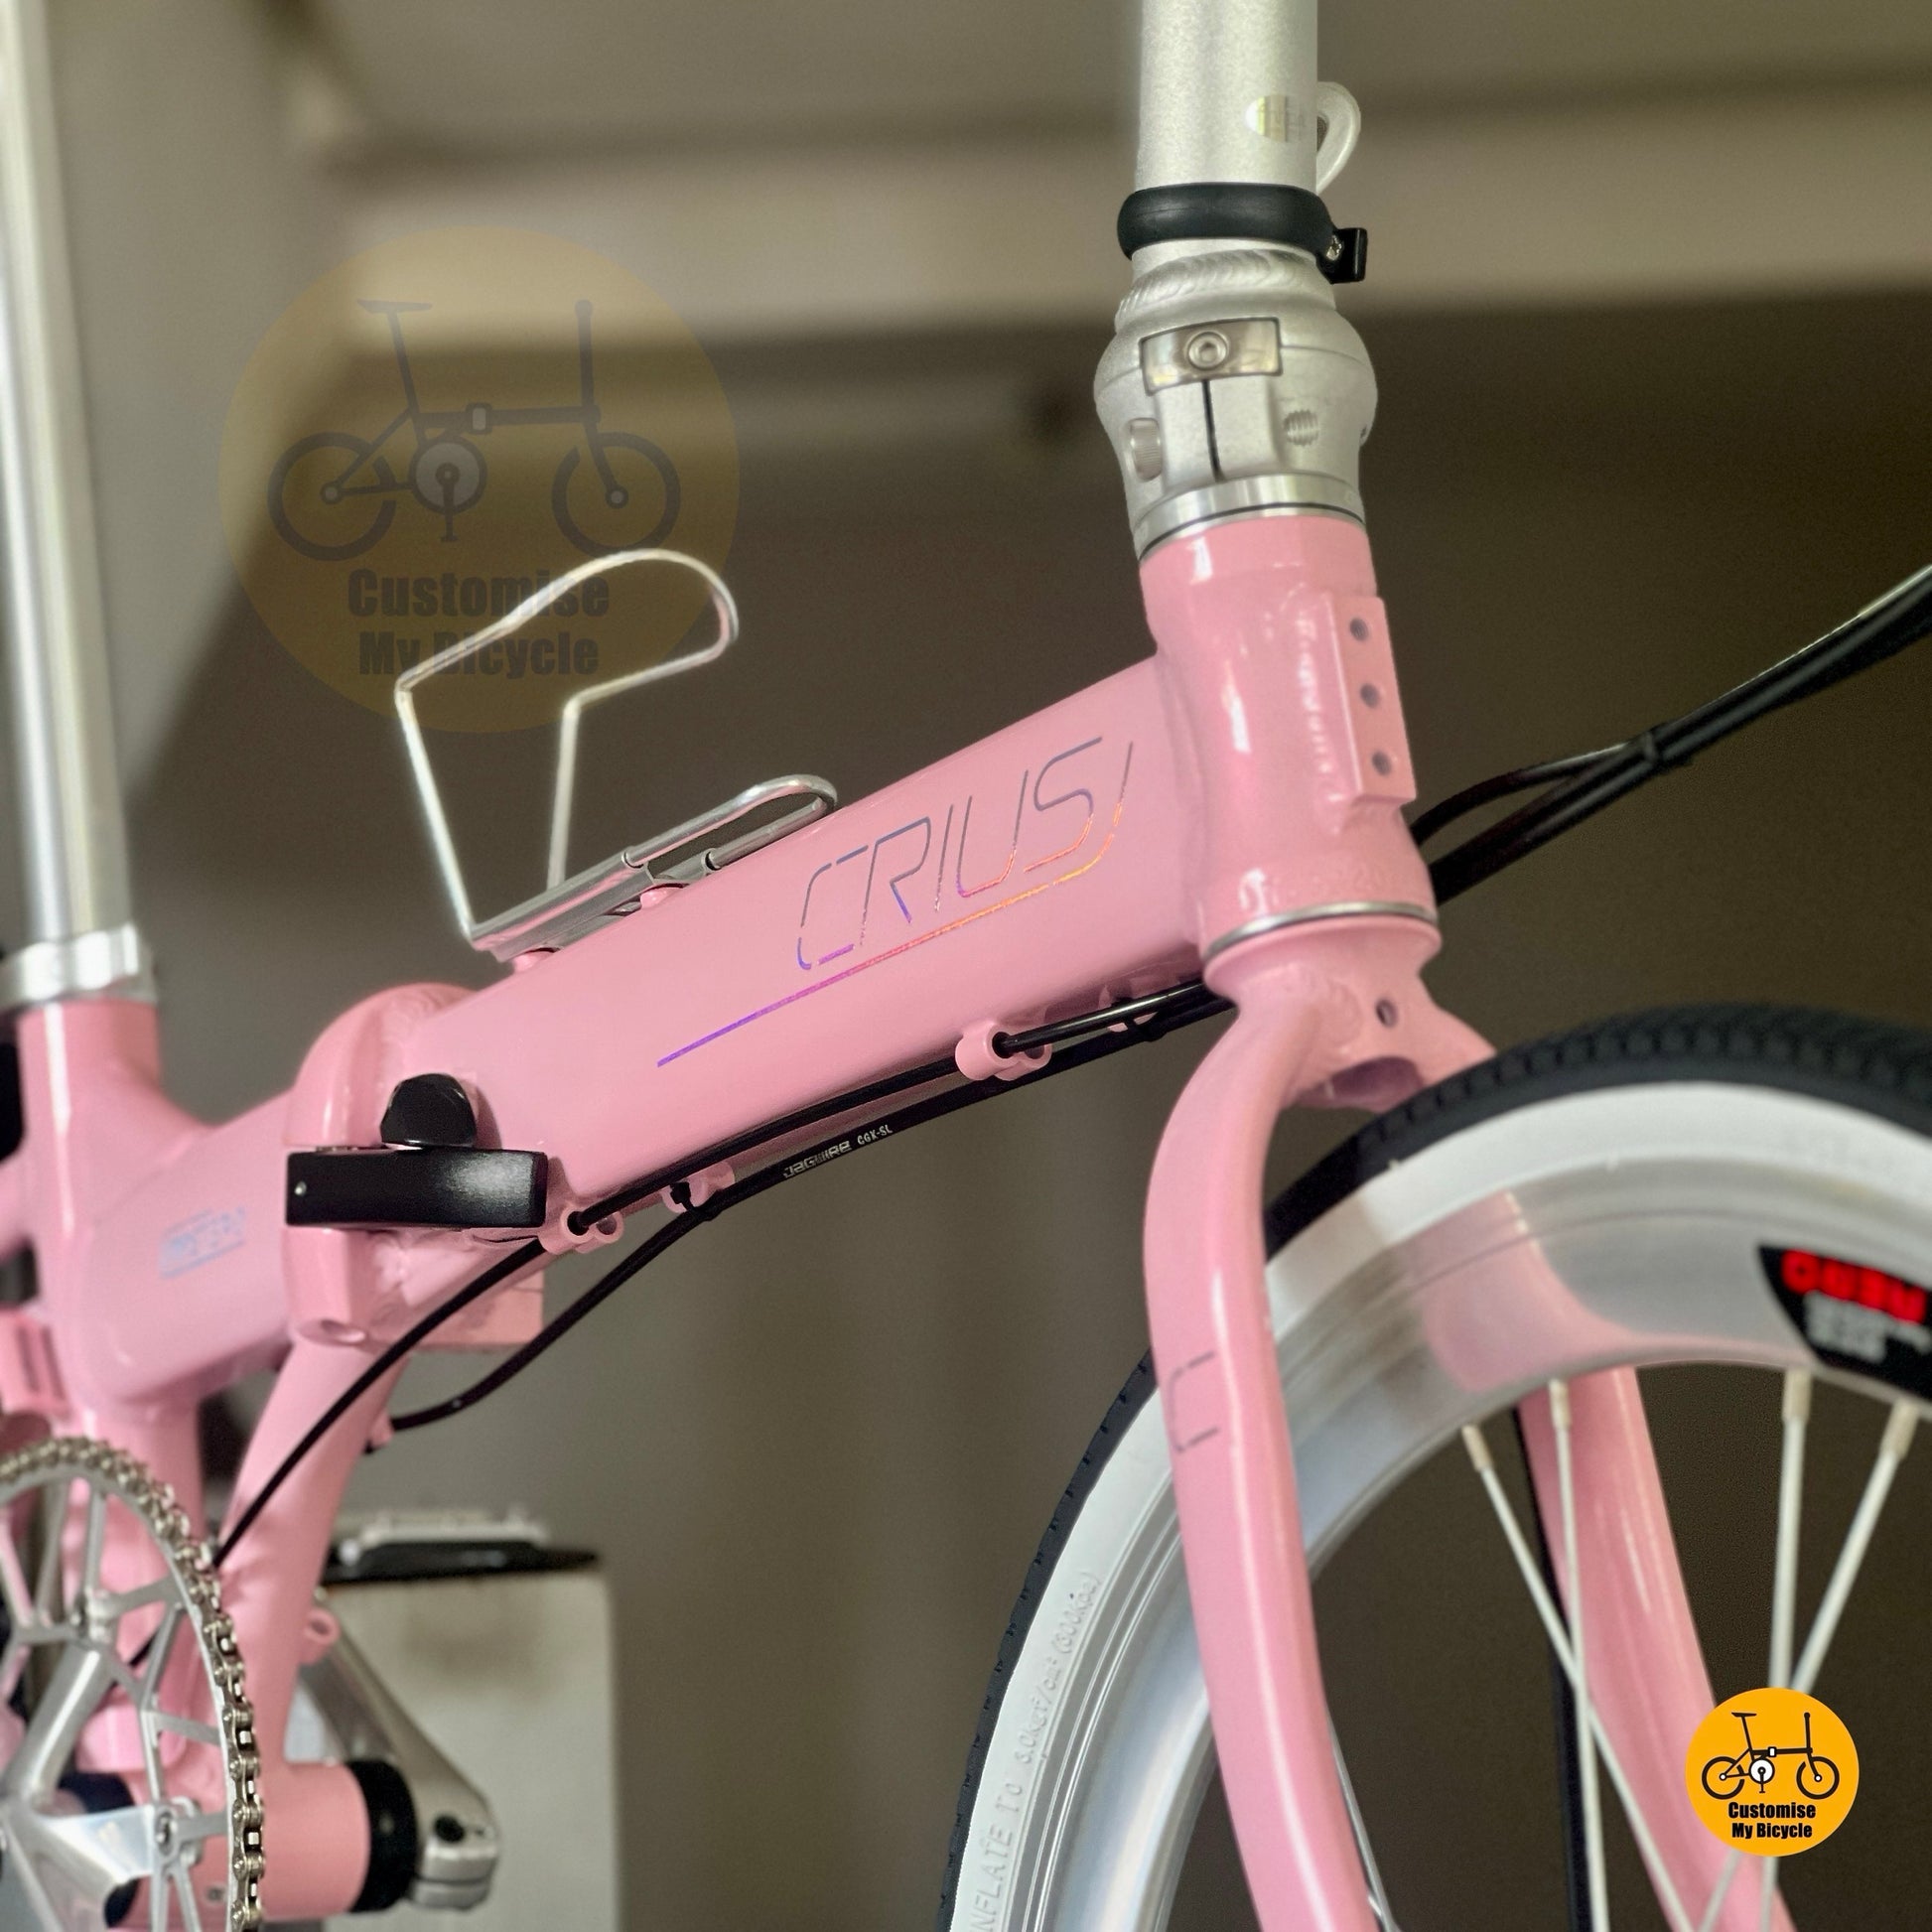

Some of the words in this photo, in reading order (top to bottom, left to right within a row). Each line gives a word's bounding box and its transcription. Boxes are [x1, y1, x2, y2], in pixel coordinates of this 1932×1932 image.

[797, 737, 1103, 970] CRIUS
[857, 1124, 894, 1145] CGX-SL
[969, 1824, 1014, 1932] NFLATE
